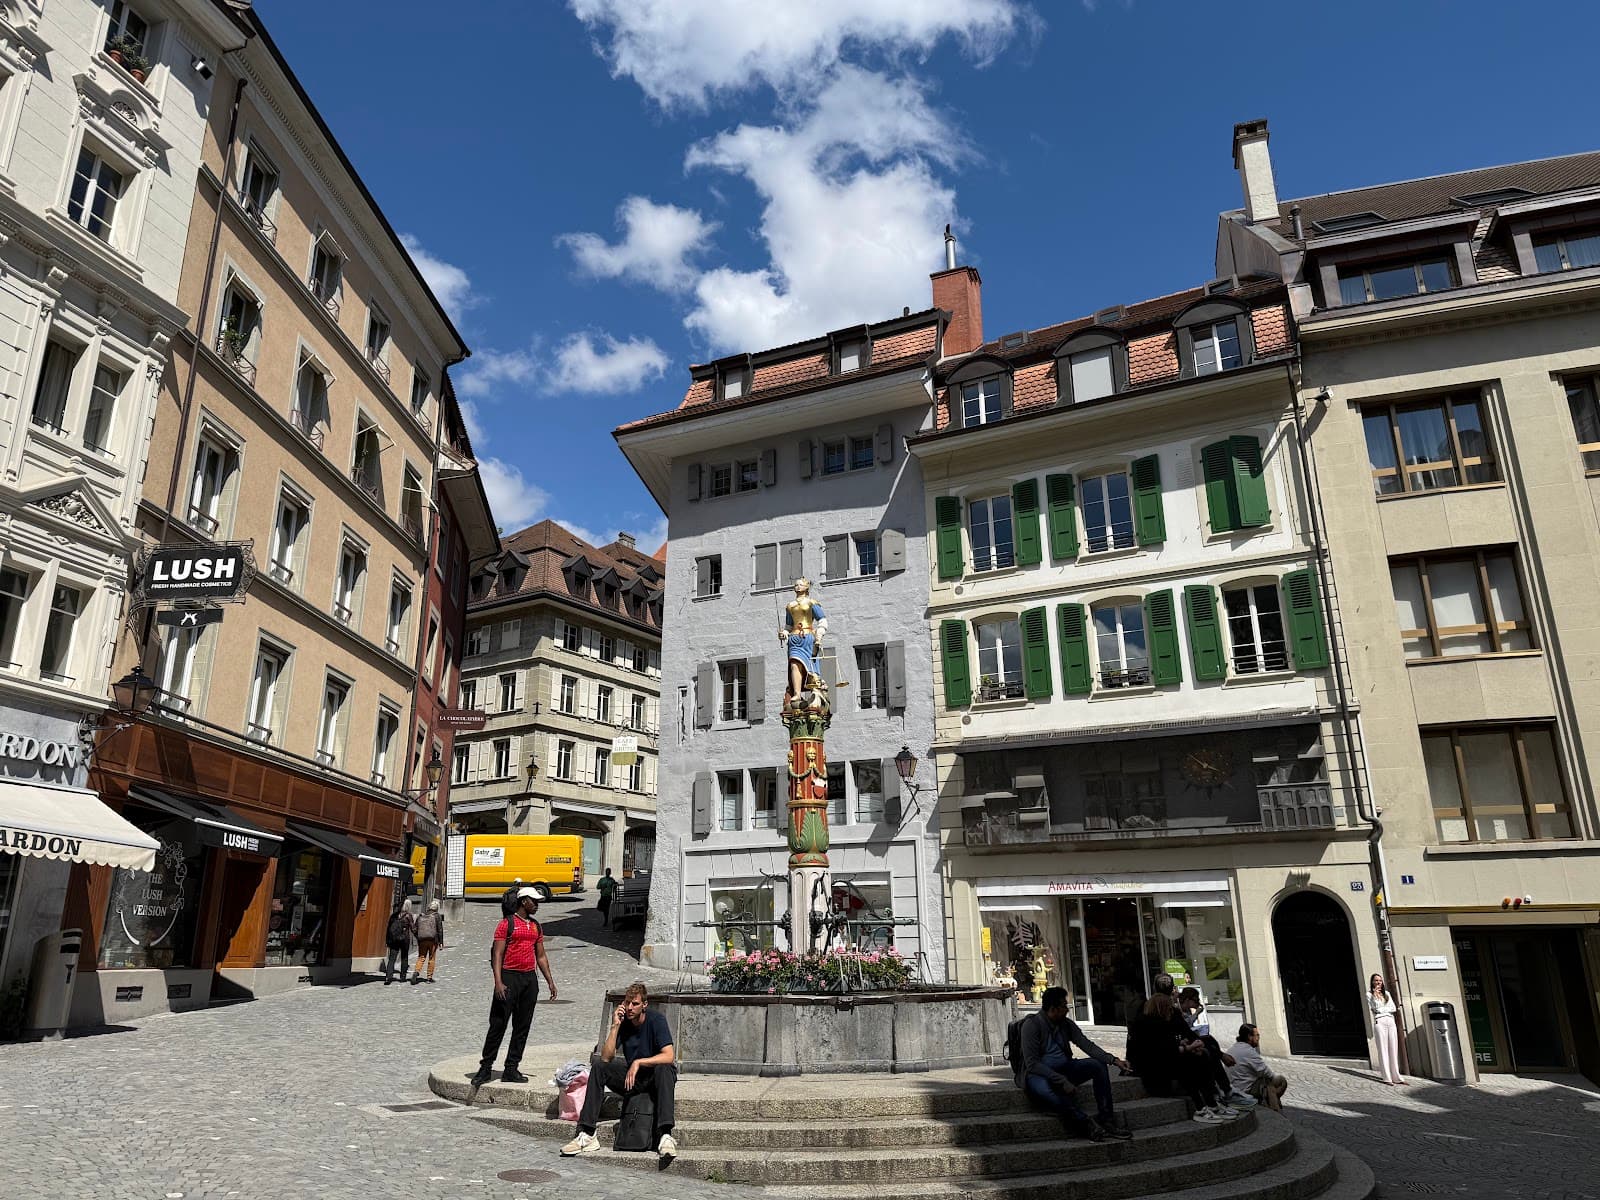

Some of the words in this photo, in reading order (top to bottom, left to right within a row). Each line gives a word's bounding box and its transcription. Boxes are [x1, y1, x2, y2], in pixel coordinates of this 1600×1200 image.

[152, 557, 236, 582] LUSH
[223, 832, 248, 850] LUSH
[376, 863, 393, 877] LUSH
[148, 873, 163, 885] THE
[1048, 880, 1094, 893] AMAVITA
[141, 888, 164, 901] LUSH
[132, 904, 168, 917] VERSION
